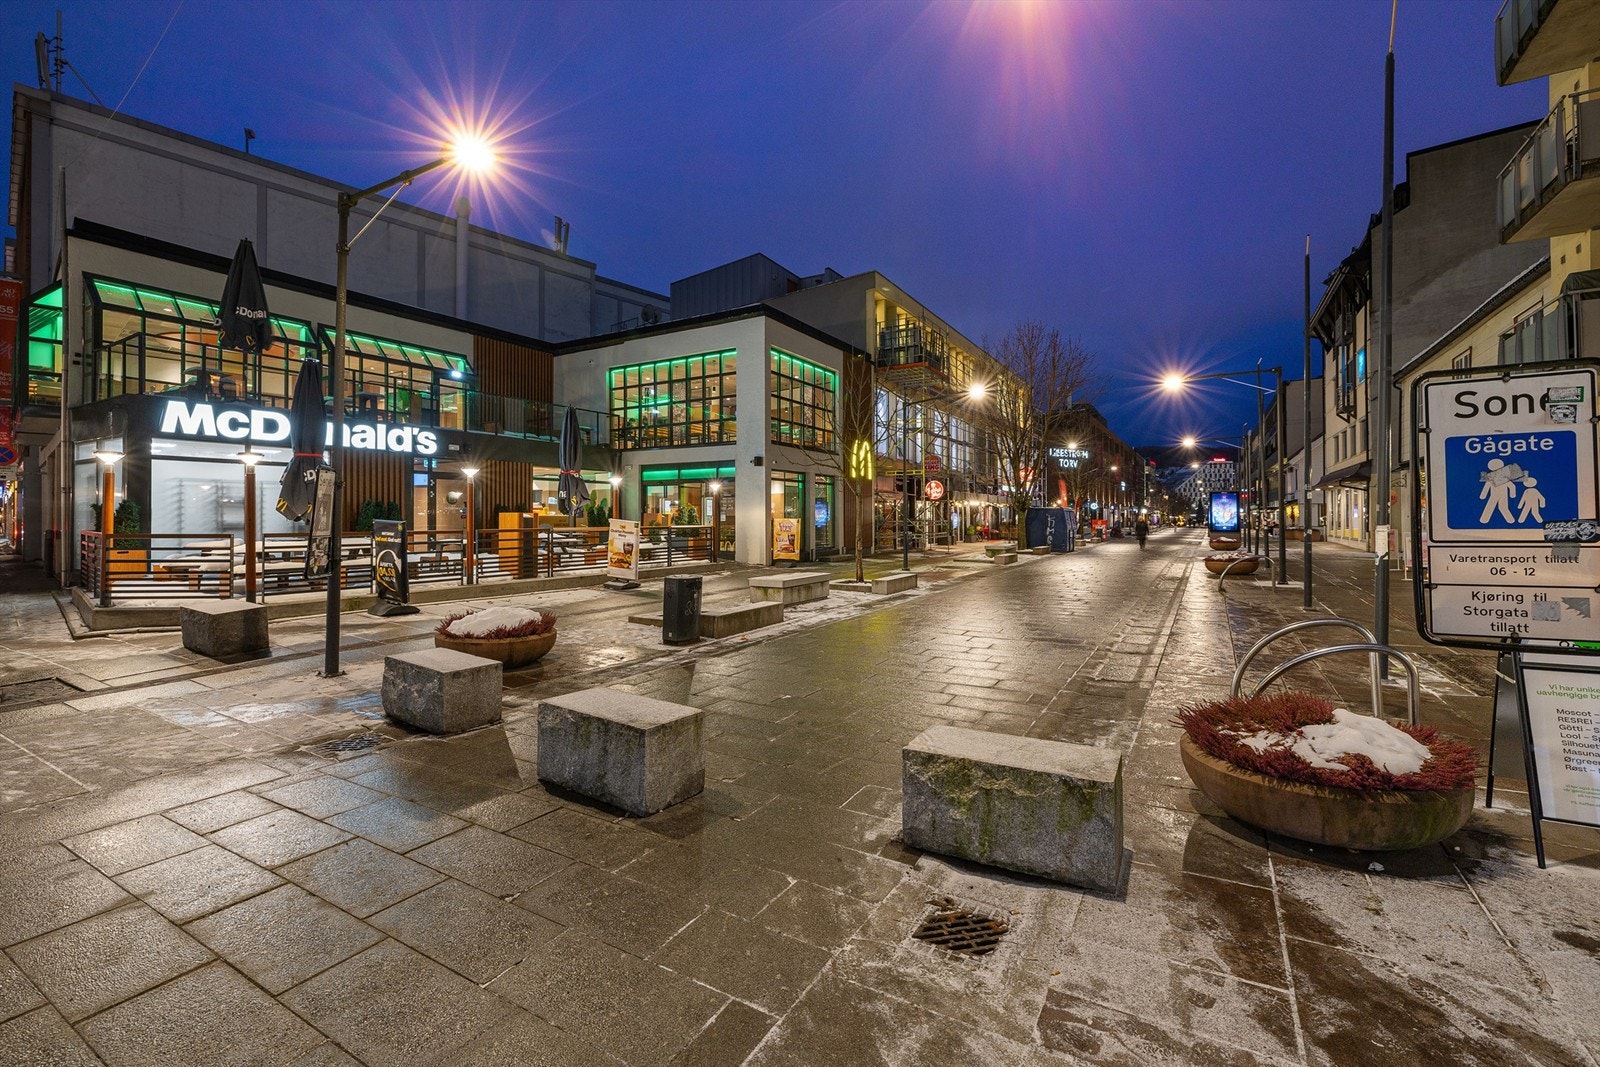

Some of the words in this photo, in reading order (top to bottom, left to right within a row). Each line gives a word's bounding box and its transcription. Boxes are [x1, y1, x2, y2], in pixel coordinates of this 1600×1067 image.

[161, 400, 438, 455] McDnald's
[1464, 434, 1554, 456] Gågate
[1449, 554, 1537, 565] Varetransport
[1544, 554, 1580, 564] tillatt
[1490, 567, 1507, 576] 06
[1523, 567, 1536, 577] 12
[1471, 591, 1524, 604] Kjøring
[1533, 592, 1547, 602] til
[1463, 606, 1529, 618] Storgata
[1490, 622, 1530, 634] tillatt
[1536, 690, 1588, 699] uavhengige
[1556, 708, 1592, 717] Moscot
[1557, 716, 1593, 725] RESREI
[1558, 724, 1583, 732] Götti
[1560, 732, 1581, 740] Lool
[1565, 764, 1588, 773] Røst
